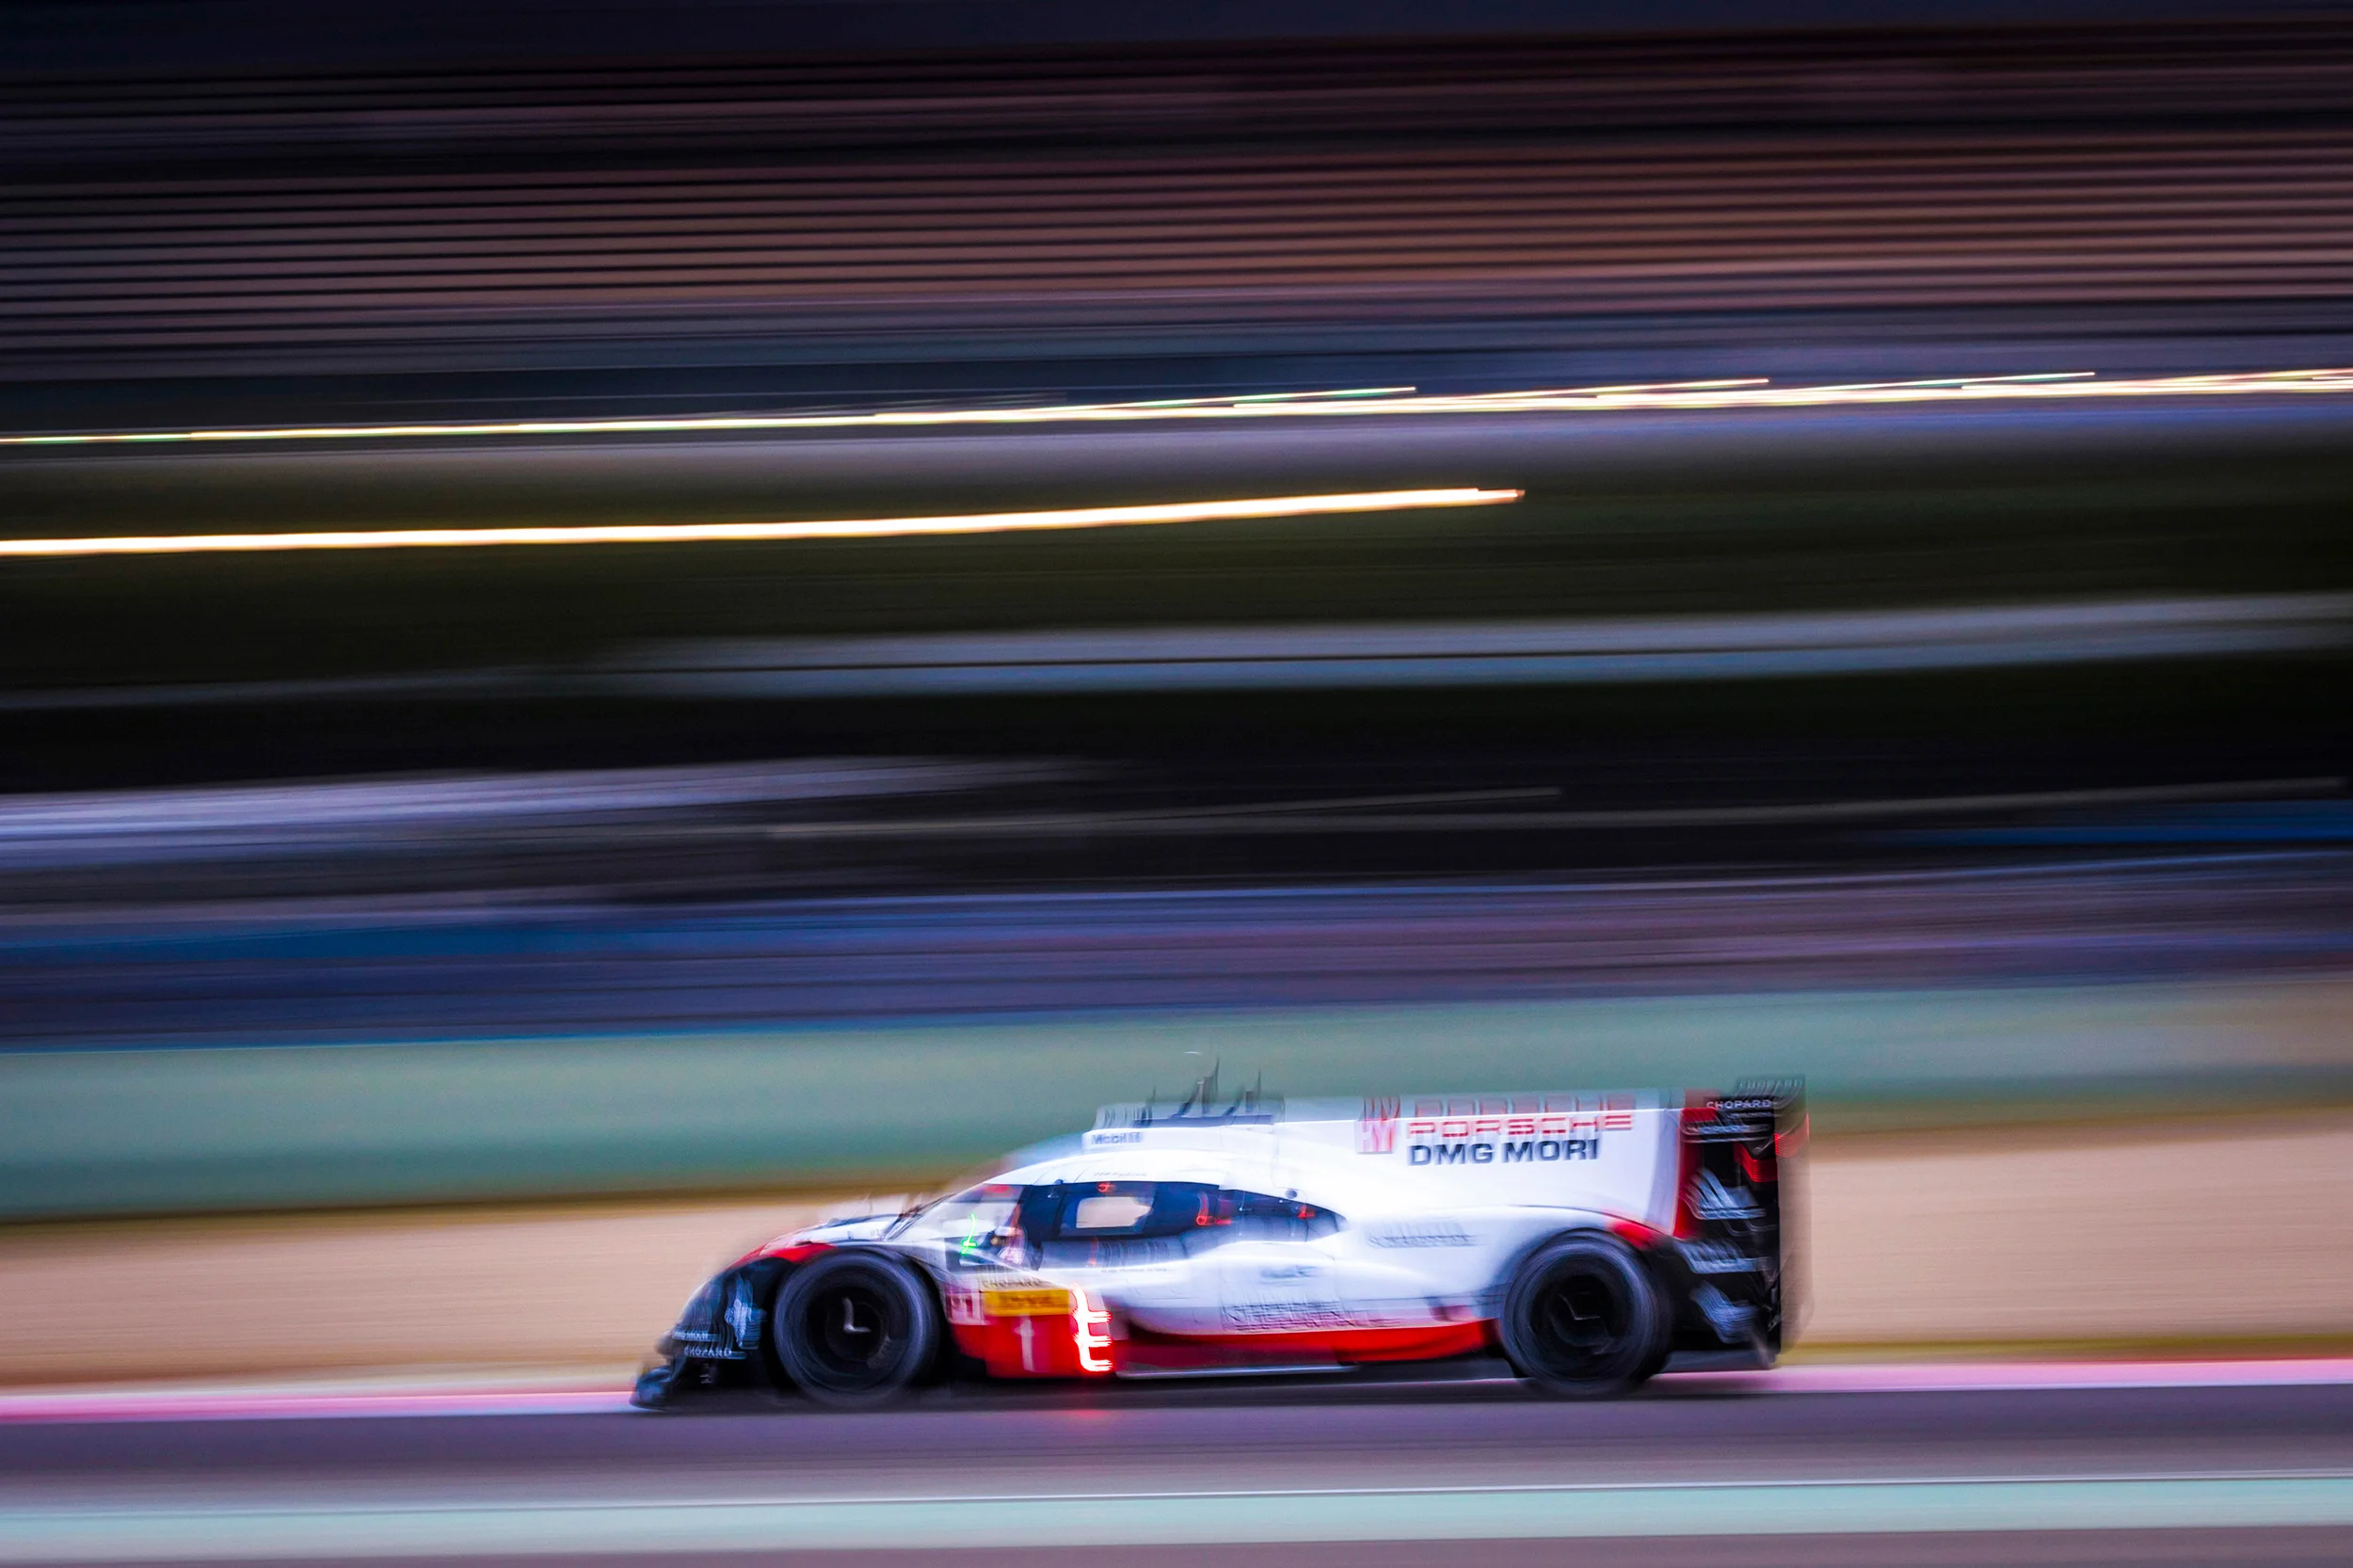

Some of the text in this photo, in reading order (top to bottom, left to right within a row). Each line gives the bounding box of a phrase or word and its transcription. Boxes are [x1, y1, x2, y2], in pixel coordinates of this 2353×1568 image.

[1705, 1099, 1771, 1110] CHOPARD
[1408, 1114, 1632, 1138] PORSCHE
[1409, 1139, 1598, 1166] DMG MORI
[684, 1346, 732, 1357] CHOPARD
